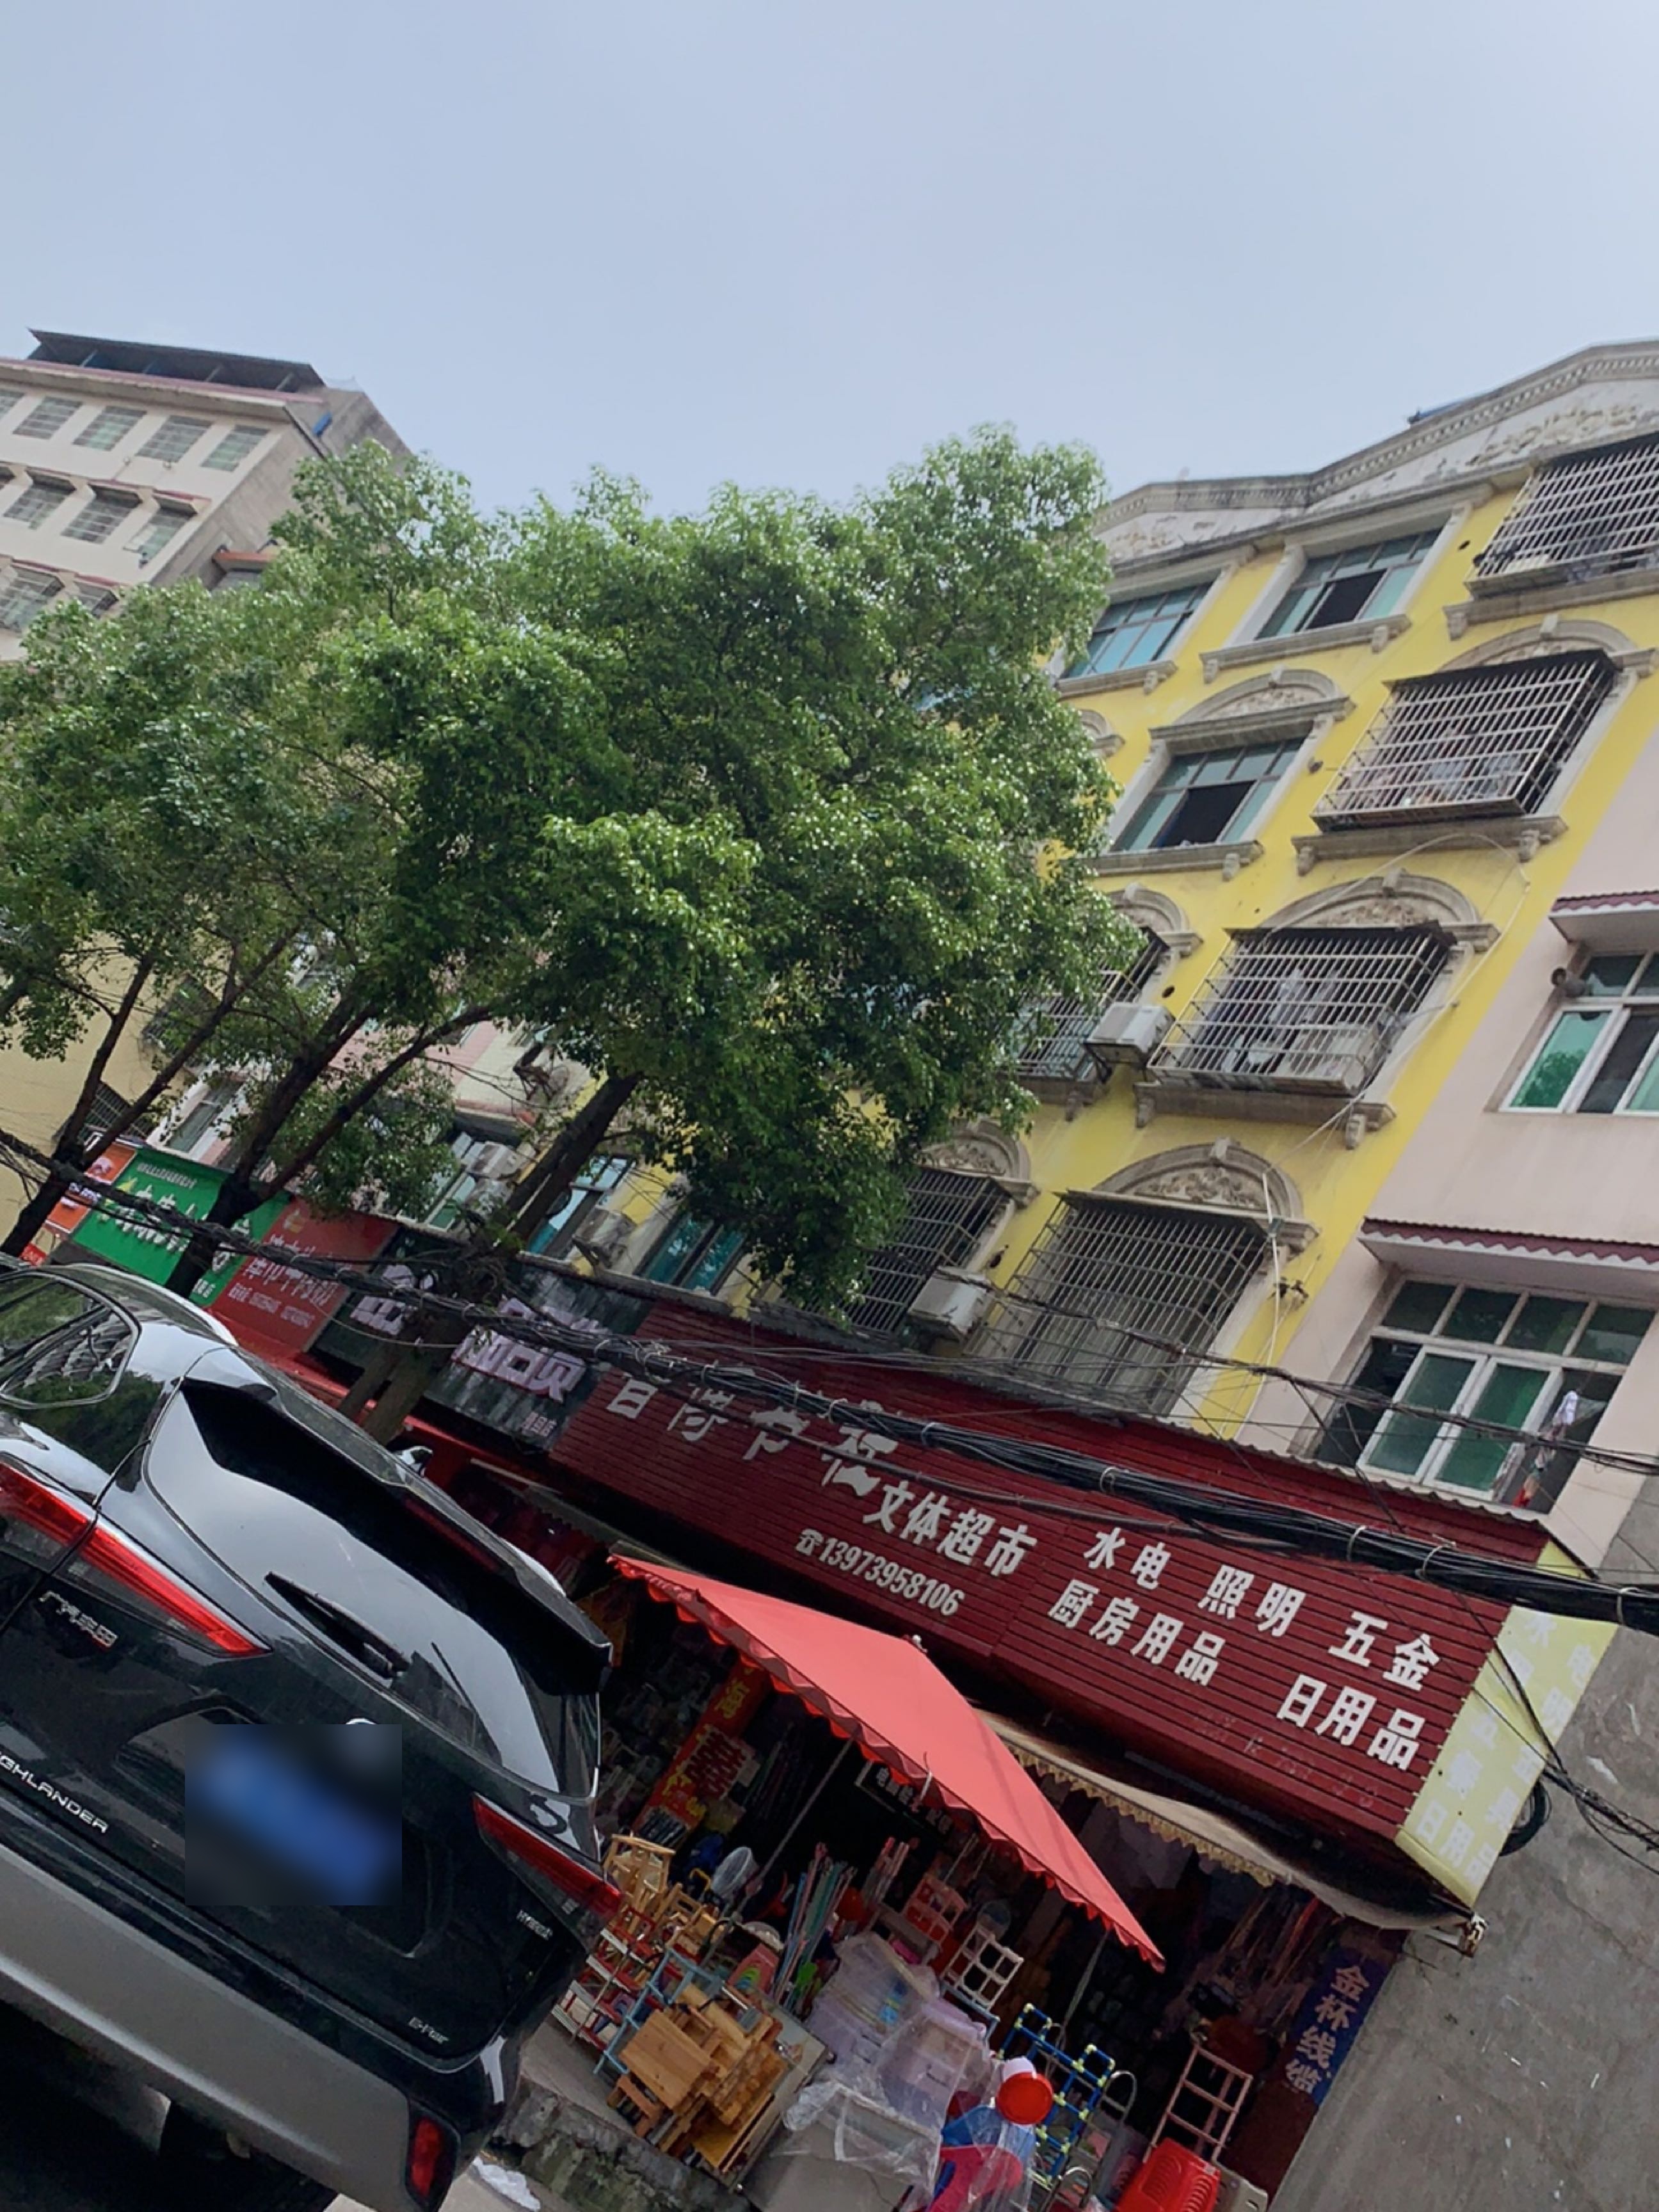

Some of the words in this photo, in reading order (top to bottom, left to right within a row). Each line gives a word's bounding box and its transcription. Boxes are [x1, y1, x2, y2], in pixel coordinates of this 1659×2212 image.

[862, 1480, 1038, 1577] 文体超市
[819, 1537, 965, 1617] 13973958106
[1084, 1527, 1171, 1590] 水电
[1198, 1564, 1306, 1637] 照明
[1328, 1611, 1440, 1691] 五金
[1048, 1579, 1226, 1687] 厨房用品
[1277, 1674, 1425, 1770] 日用品
[0, 1752, 109, 1834] GHLANDER
